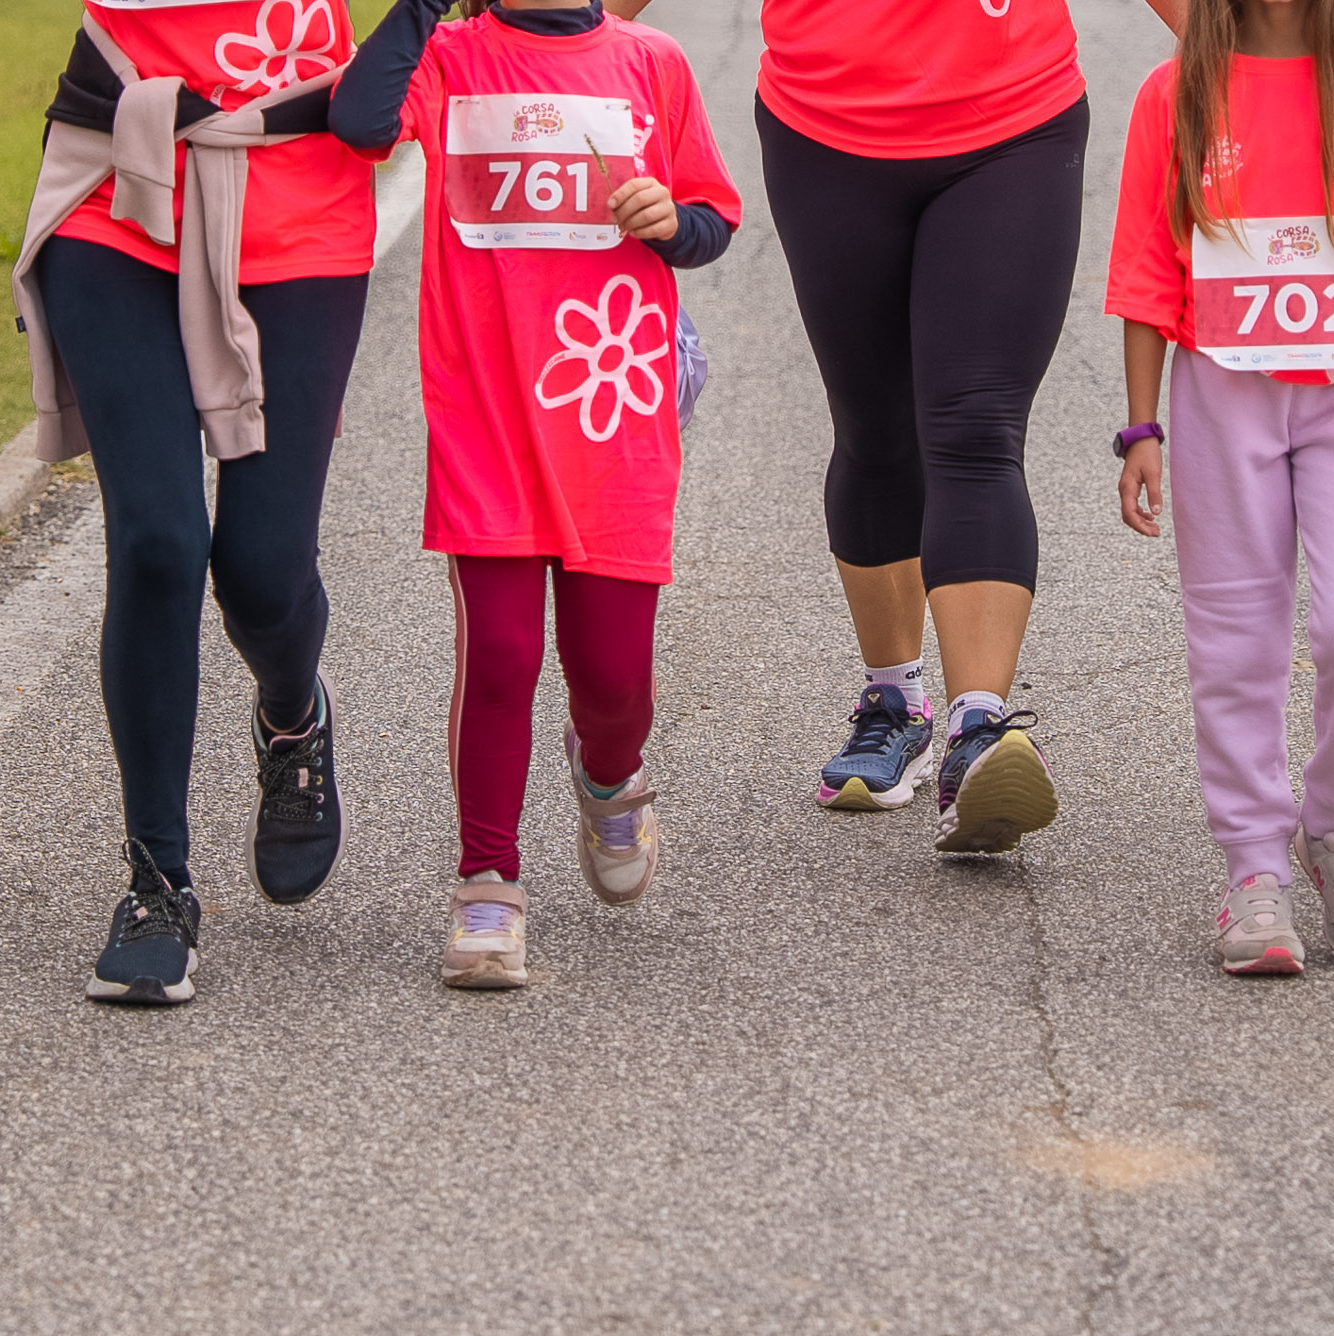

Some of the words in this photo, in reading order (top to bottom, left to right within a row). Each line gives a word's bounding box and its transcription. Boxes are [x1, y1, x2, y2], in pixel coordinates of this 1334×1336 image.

[521, 102, 555, 115] CORSA
[511, 129, 538, 143] ROSA
[488, 159, 588, 212] 761
[1276, 225, 1310, 239] CORSA
[1266, 253, 1294, 266] ROSA
